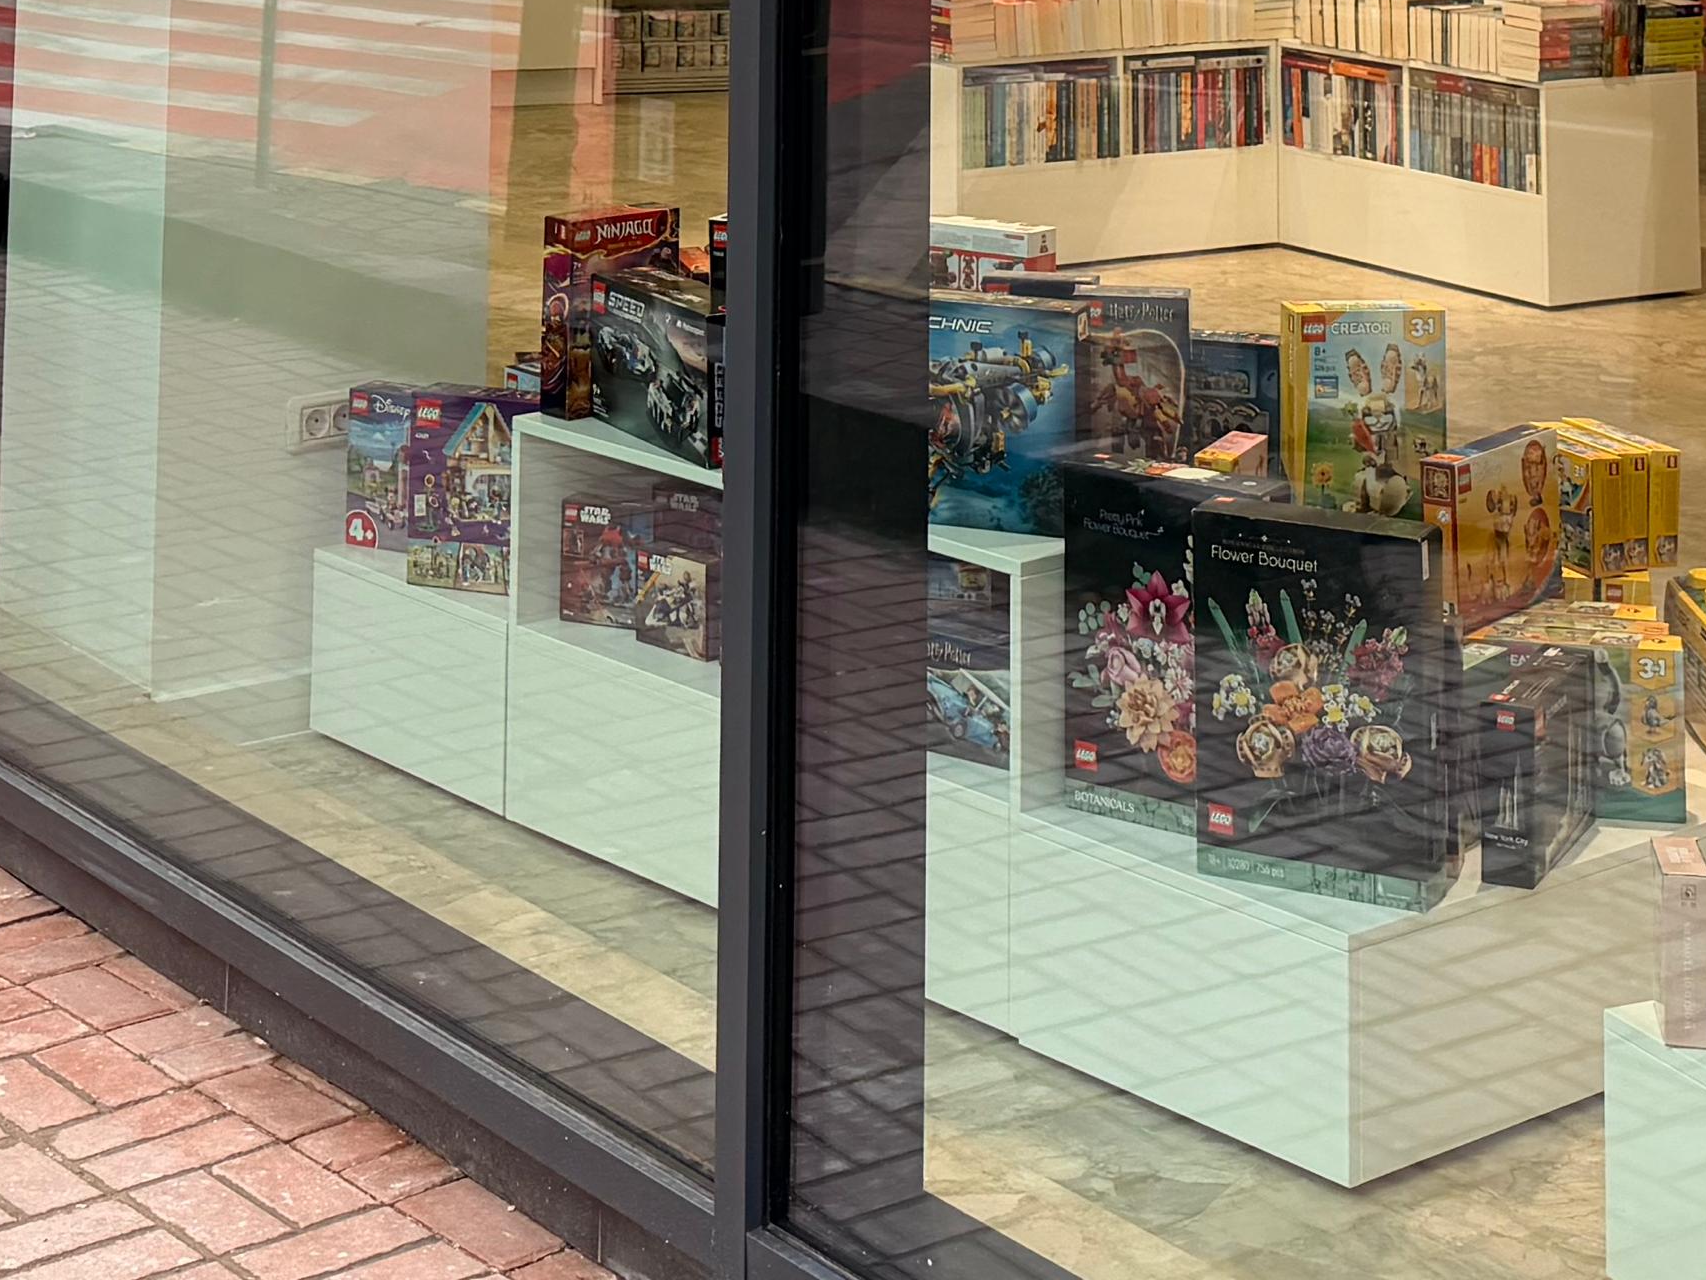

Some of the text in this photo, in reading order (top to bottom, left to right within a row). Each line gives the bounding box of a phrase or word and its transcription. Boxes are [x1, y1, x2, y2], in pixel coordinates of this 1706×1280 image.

[594, 218, 656, 244] NINJAGO
[608, 291, 645, 317] SPEED
[1141, 302, 1174, 323] Potter
[929, 316, 992, 334] CHNIC
[1331, 320, 1392, 335] CREATOR
[417, 406, 442, 421] LEGO
[349, 518, 374, 541] 4+
[1211, 544, 1254, 565] Flower
[1258, 551, 1318, 574] Bouquet
[1074, 790, 1135, 814] BOTANICALS
